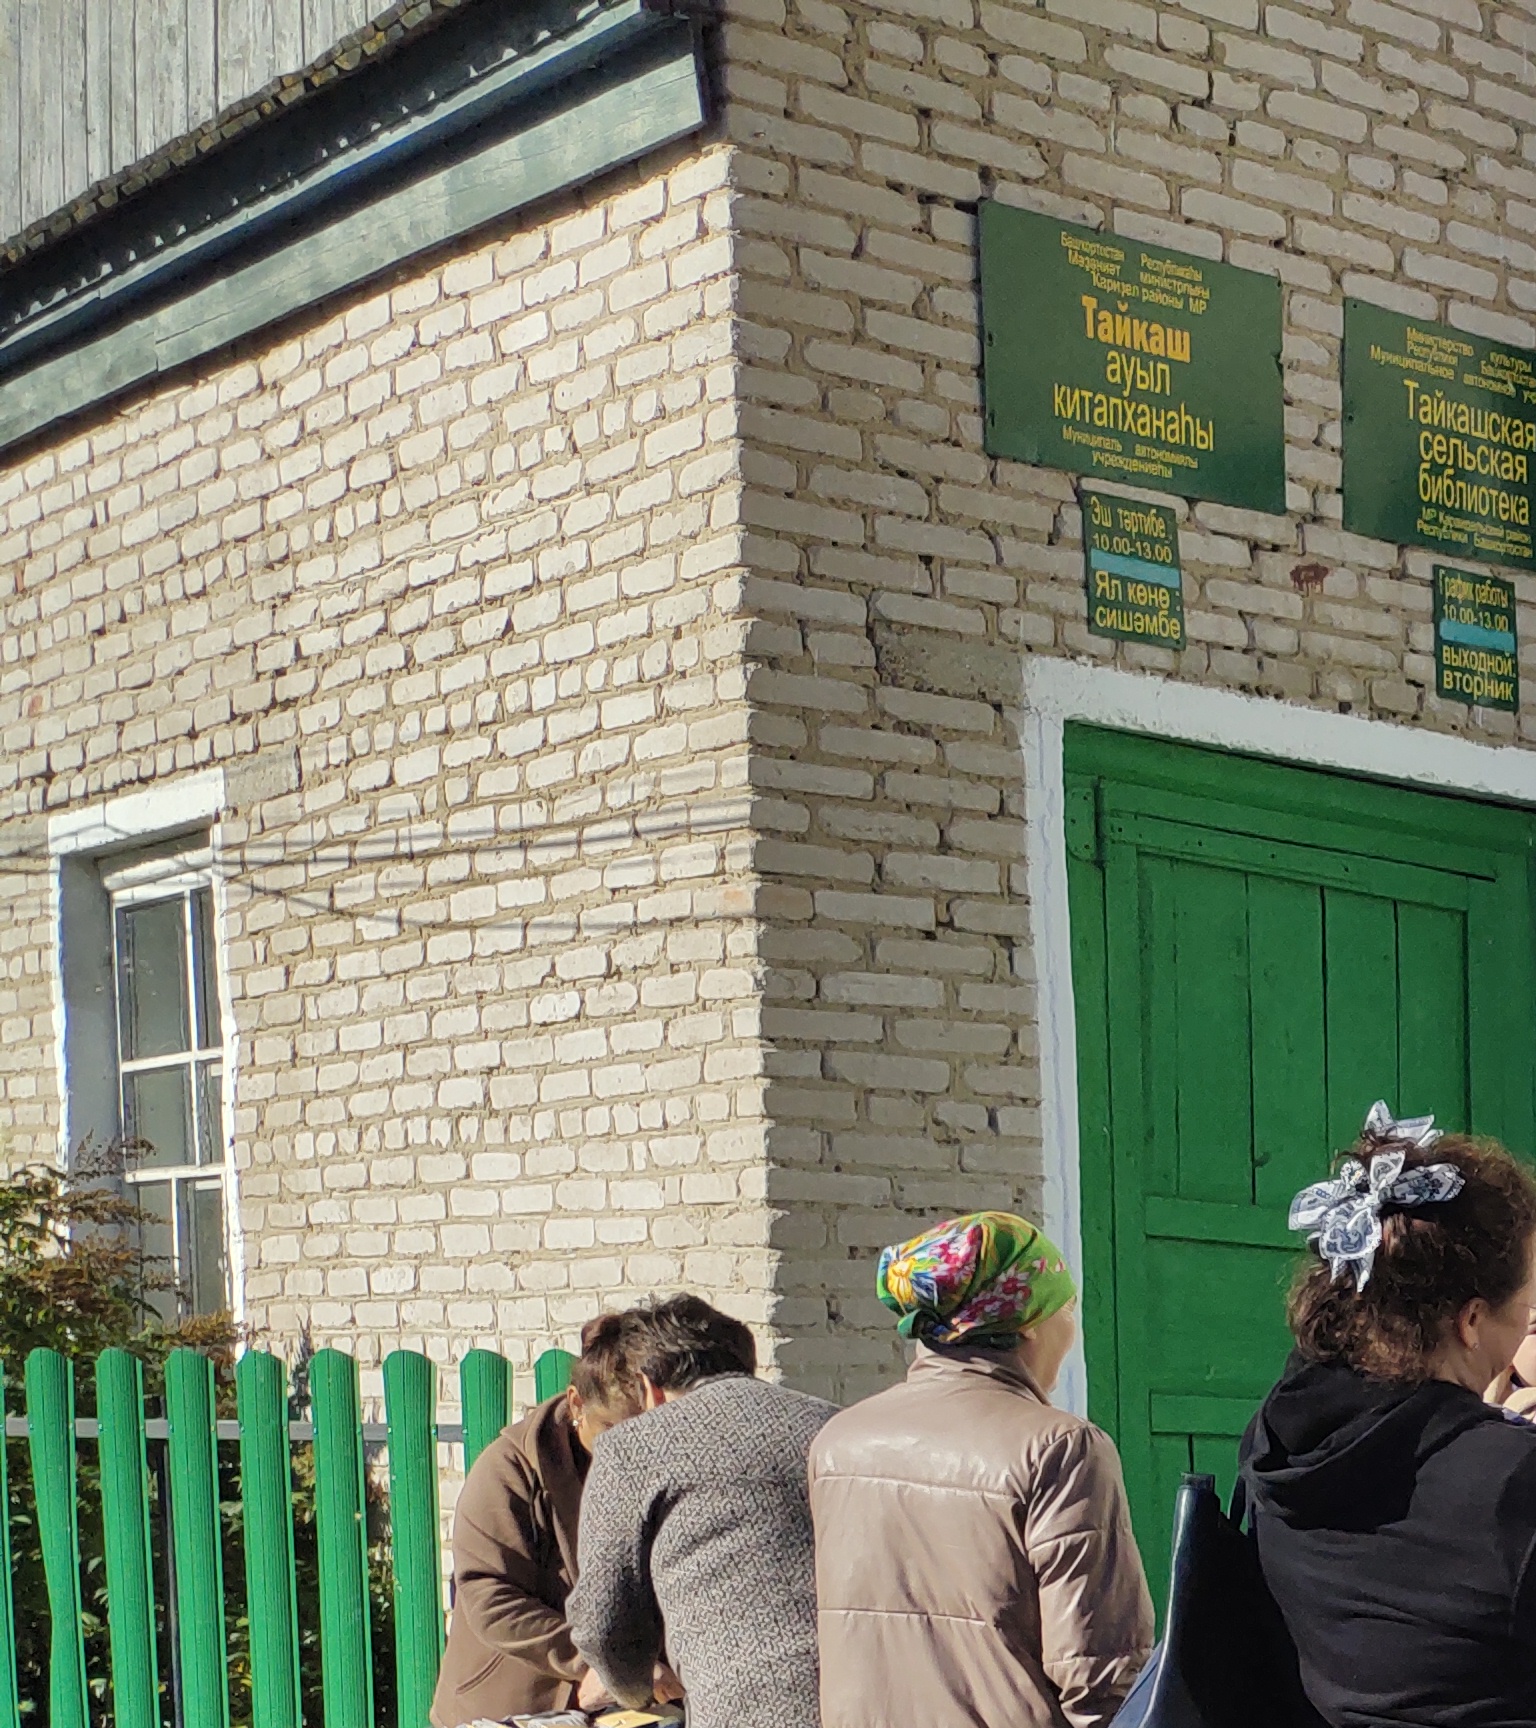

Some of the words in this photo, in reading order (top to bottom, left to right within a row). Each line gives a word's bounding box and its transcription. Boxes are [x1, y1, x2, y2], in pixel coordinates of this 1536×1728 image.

[1081, 295, 1191, 363] Тайкаш
[1188, 297, 1207, 315] МР
[1105, 350, 1171, 397] ауыл
[1053, 382, 1214, 452] китапханаһы
[1403, 378, 1536, 453] Тайкашская
[1419, 430, 1528, 484] сельская
[1090, 495, 1113, 528] Эш
[1418, 462, 1530, 526] библиотека
[1092, 532, 1173, 564] 10.00-13.00
[1095, 570, 1122, 603] Ял
[1442, 604, 1509, 633] 10.00-13.00
